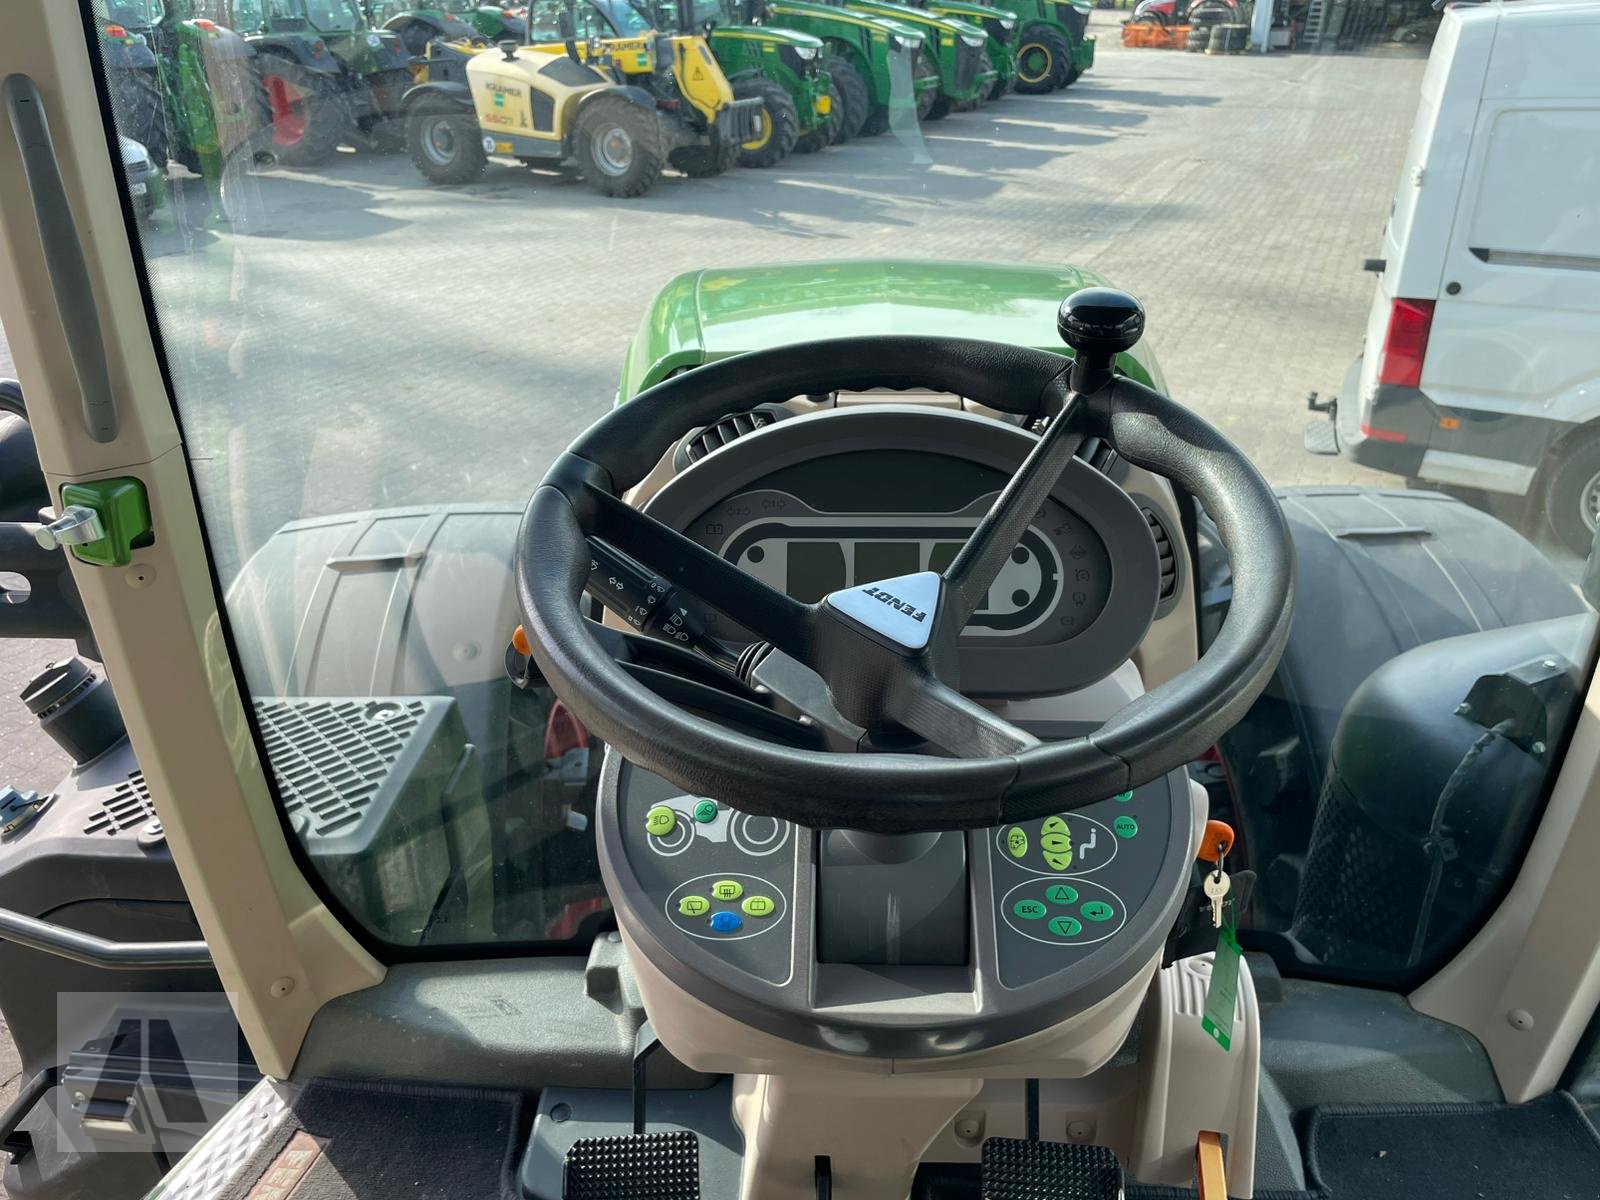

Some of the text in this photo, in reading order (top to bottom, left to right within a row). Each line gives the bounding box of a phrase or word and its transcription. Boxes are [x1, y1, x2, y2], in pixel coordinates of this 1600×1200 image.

[485, 82, 522, 98] KRAMER
[862, 587, 927, 623] FENDT
[1116, 823, 1135, 831] AUTO
[1021, 905, 1038, 914] ESC
